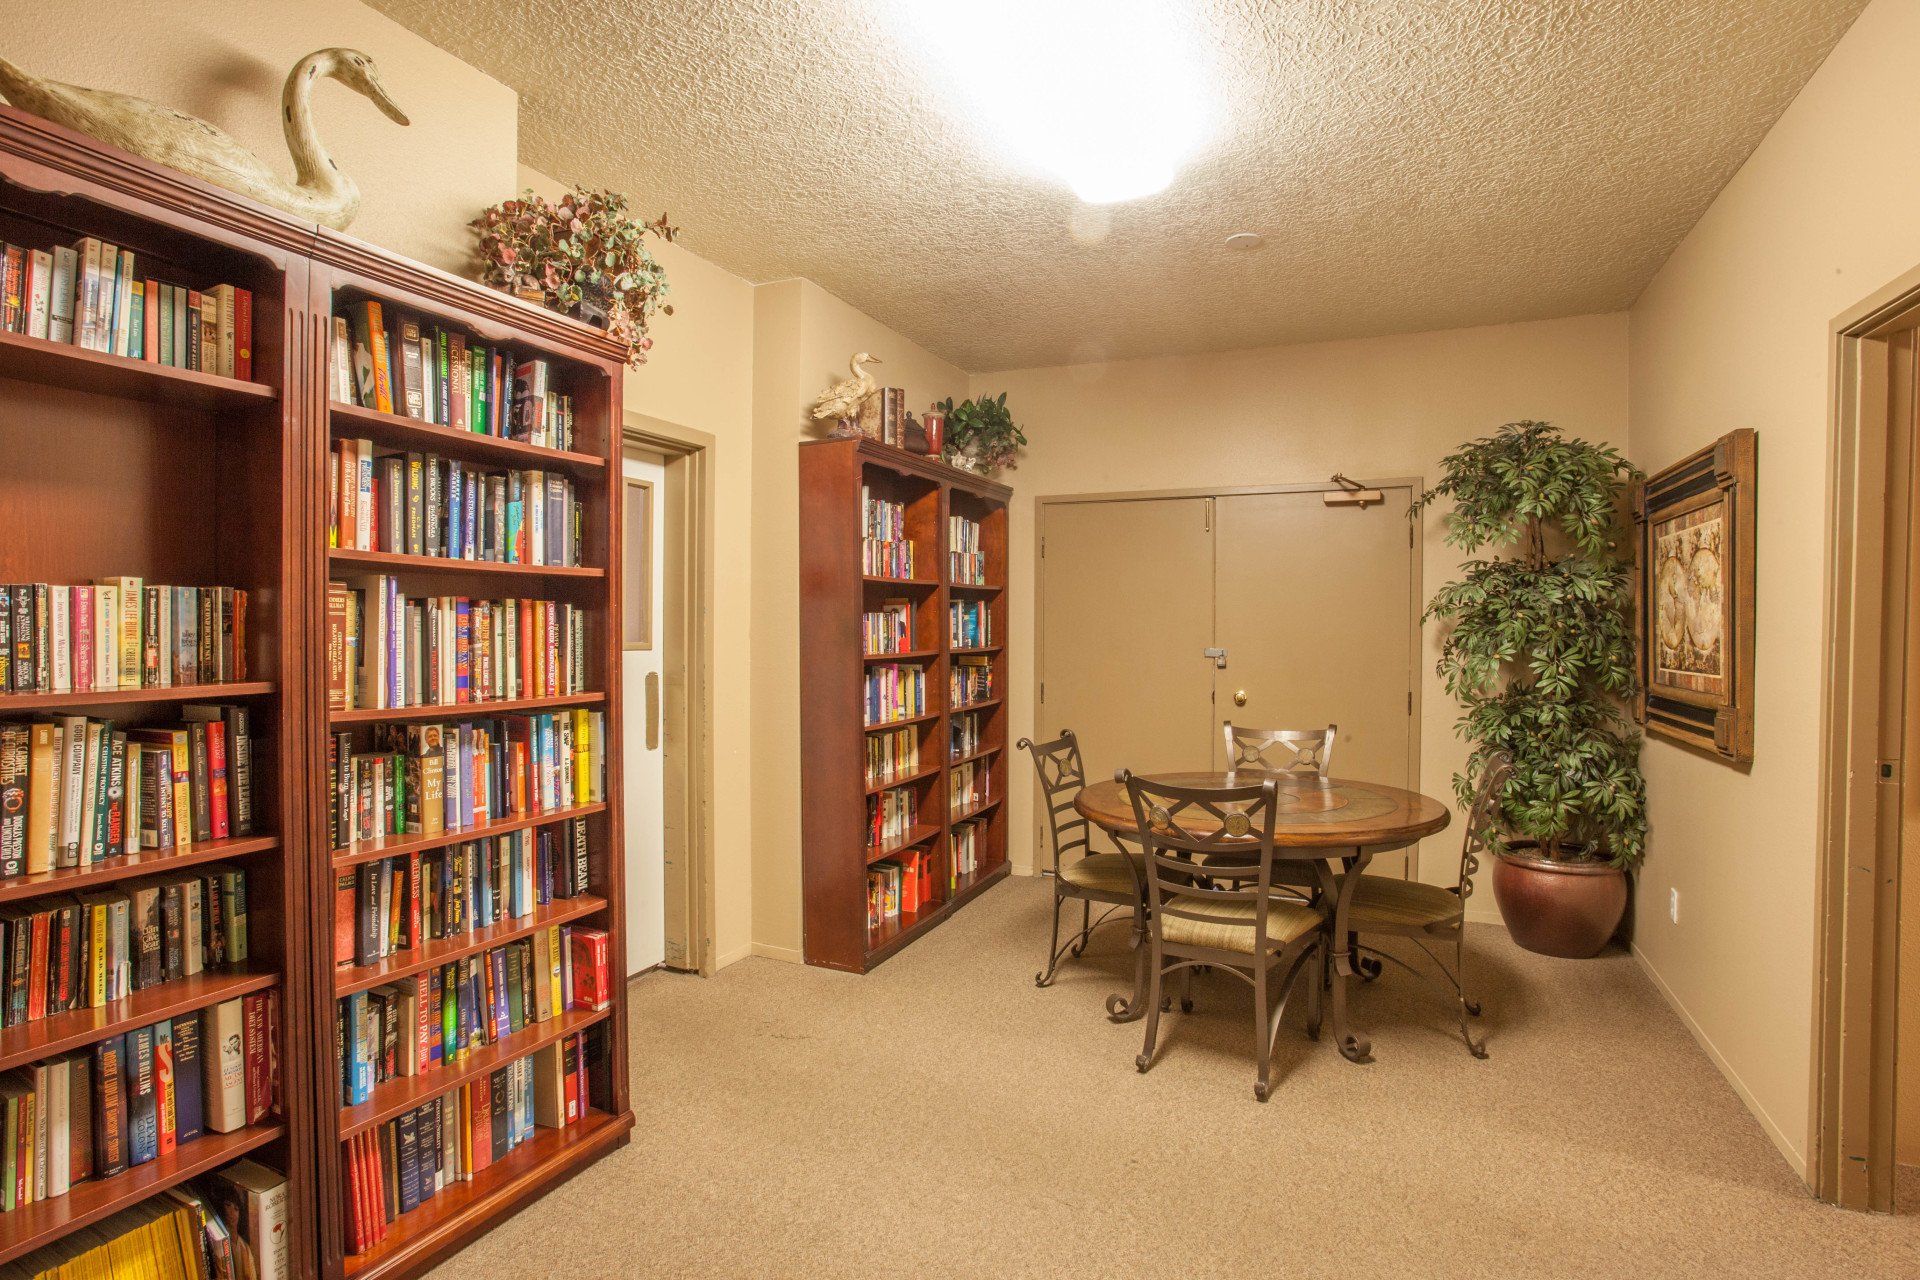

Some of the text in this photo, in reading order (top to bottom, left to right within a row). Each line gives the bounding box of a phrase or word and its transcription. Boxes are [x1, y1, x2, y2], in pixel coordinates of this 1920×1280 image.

[451, 340, 460, 395] RECESSIONAL
[125, 590, 138, 640] JAMES LEE BURKE
[126, 648, 136, 682] CREOLE BELLE
[73, 724, 83, 742] GOOD
[0, 731, 16, 785] OF CURIOSITIES
[15, 730, 28, 776] THE CABINET
[72, 744, 82, 775] COMPANY
[100, 746, 108, 775] CELESTINE
[111, 739, 122, 787] ACE ATKINS
[342, 742, 350, 764] Money
[88, 758, 97, 786] OREGON
[236, 735, 251, 821] INSIDE THE LEAGUE
[427, 779, 442, 792] My
[87, 787, 95, 812] WOMEN
[98, 776, 106, 805] PROPHECY
[424, 790, 443, 801] Life
[110, 811, 120, 844] RANGER
[161, 810, 167, 818] TO
[1, 825, 14, 844] LINCOLN
[12, 815, 24, 859] DOUGLAS PRESTON
[1, 844, 13, 859] CHILD
[576, 821, 588, 890] DEATH BEAM
[369, 906, 379, 938] Friendship
[419, 978, 428, 1045] HELL TO PAY
[249, 1029, 257, 1055] SYSTEM
[256, 1031, 264, 1064] AMERICAN
[103, 1050, 118, 1109] ROBERT LUDLUM
[138, 1033, 151, 1095] JAMES ROLLINS
[137, 1118, 146, 1155] COLONY
[146, 1115, 156, 1153] DEVIL
[108, 1138, 119, 1164] STRATEGY
